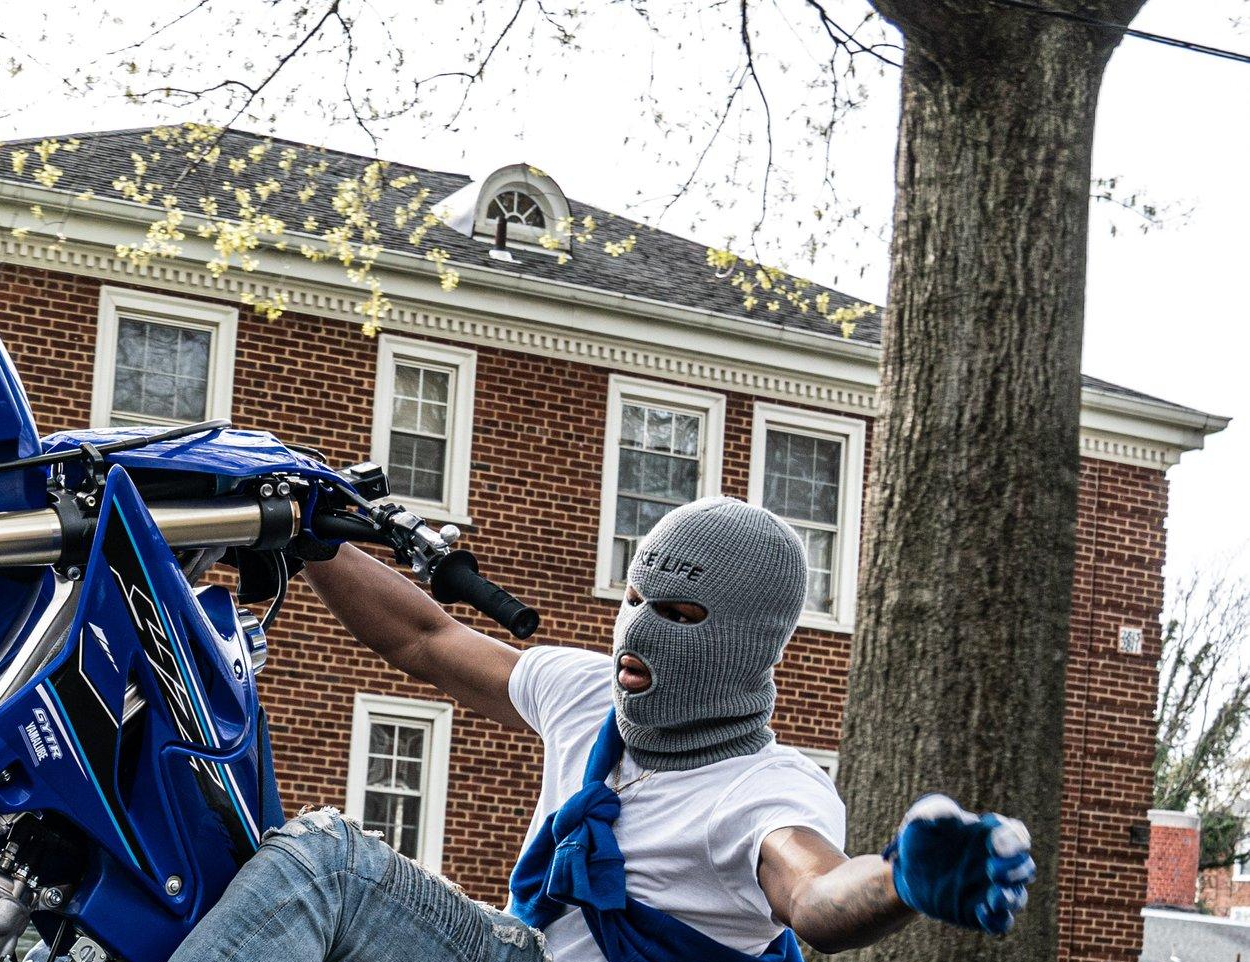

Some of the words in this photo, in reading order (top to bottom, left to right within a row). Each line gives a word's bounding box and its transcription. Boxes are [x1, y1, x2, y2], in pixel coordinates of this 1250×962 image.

[659, 555, 704, 582] LIFE
[25, 721, 49, 762] YAMALUBE
[32, 707, 63, 760] GYTR
